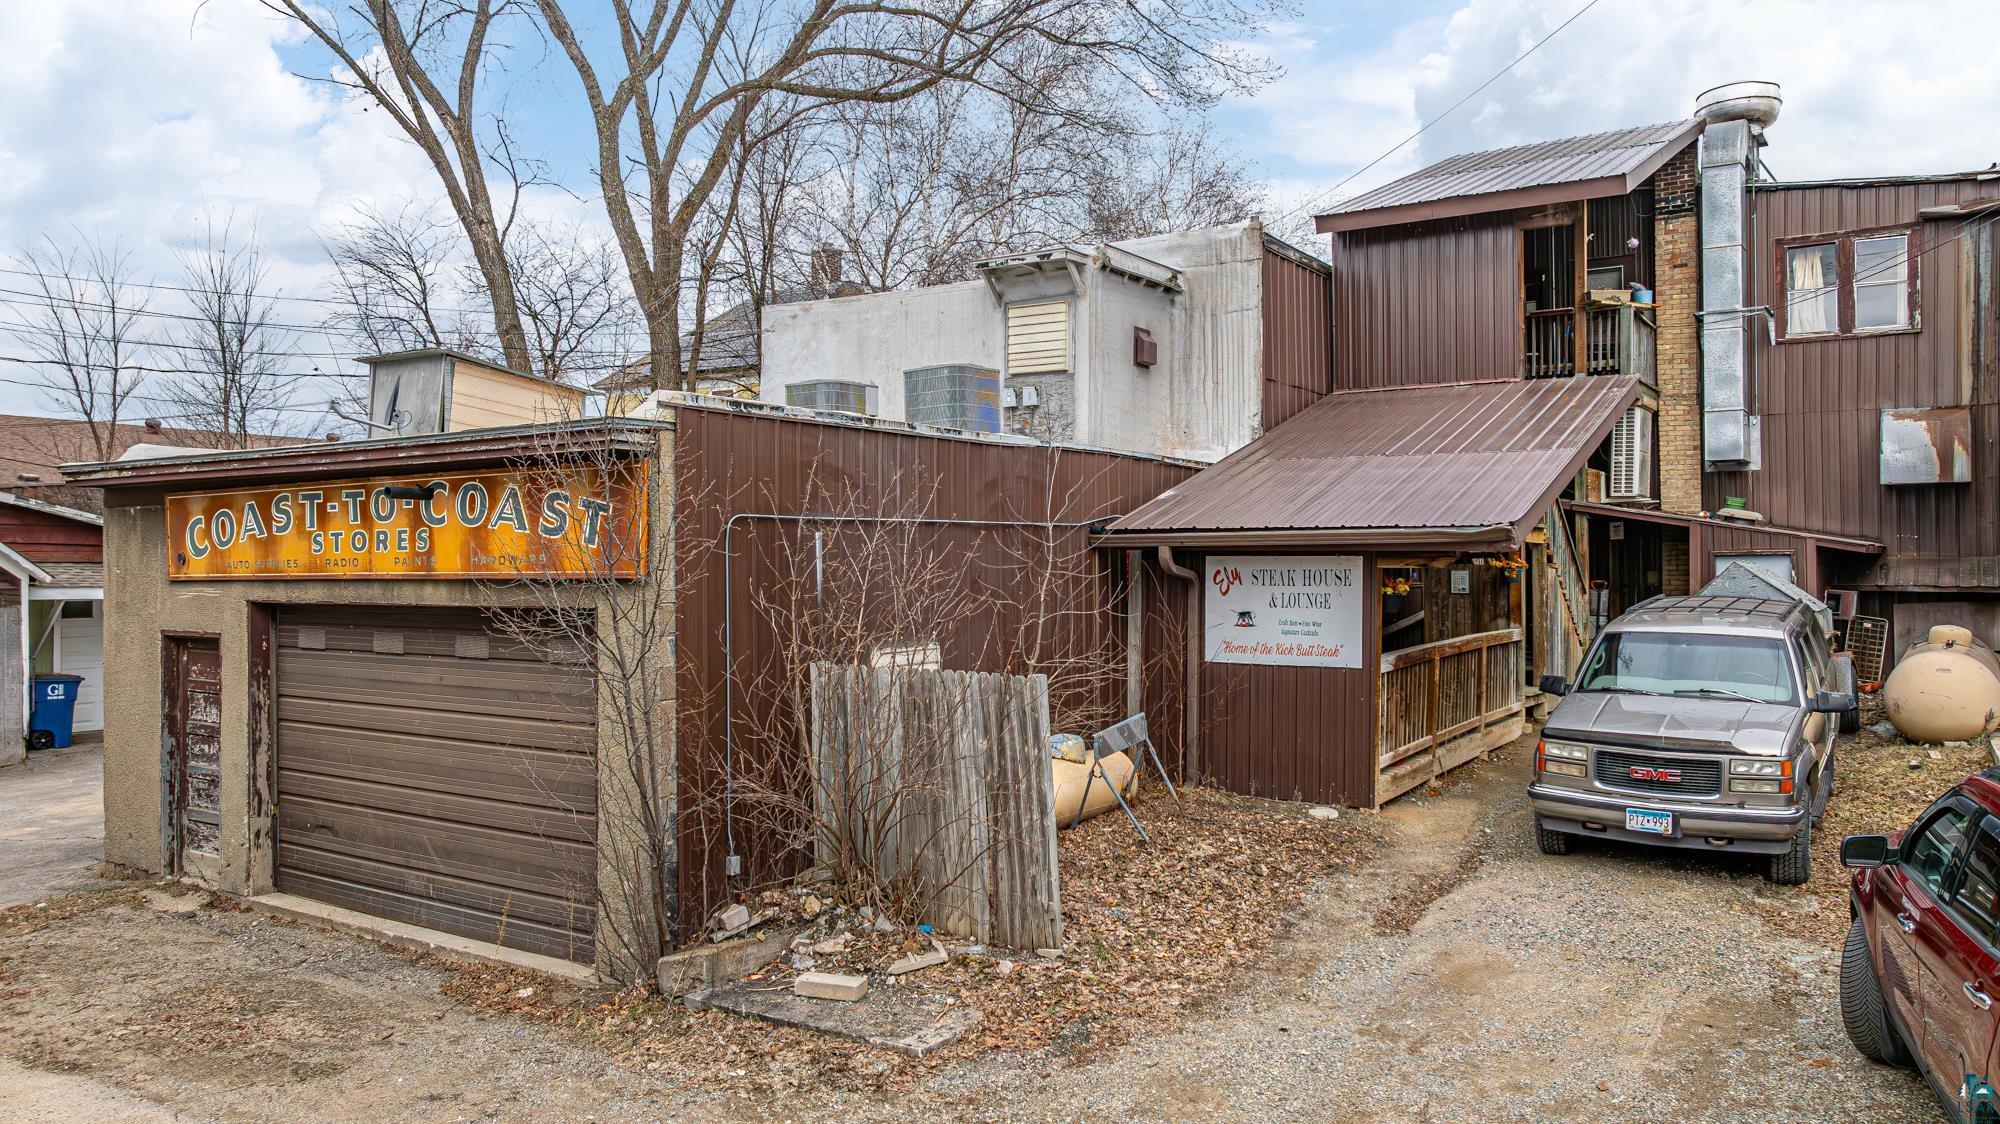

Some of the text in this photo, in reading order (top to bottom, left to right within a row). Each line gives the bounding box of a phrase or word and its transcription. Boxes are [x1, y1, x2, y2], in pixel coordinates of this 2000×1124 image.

[186, 481, 613, 560] COAST-TO-COAST
[311, 527, 430, 555] STORES
[226, 559, 250, 569] AUTO
[325, 557, 359, 568] RADIO
[1251, 568, 1296, 587] STEAK
[1303, 568, 1352, 587] HOUSE
[1268, 592, 1331, 610] & LOUNGE
[1249, 641, 1260, 658] of
[1259, 641, 1273, 656] the
[1275, 642, 1294, 656] Kick
[1296, 643, 1315, 657] Butt
[1629, 766, 1681, 782] GMC
